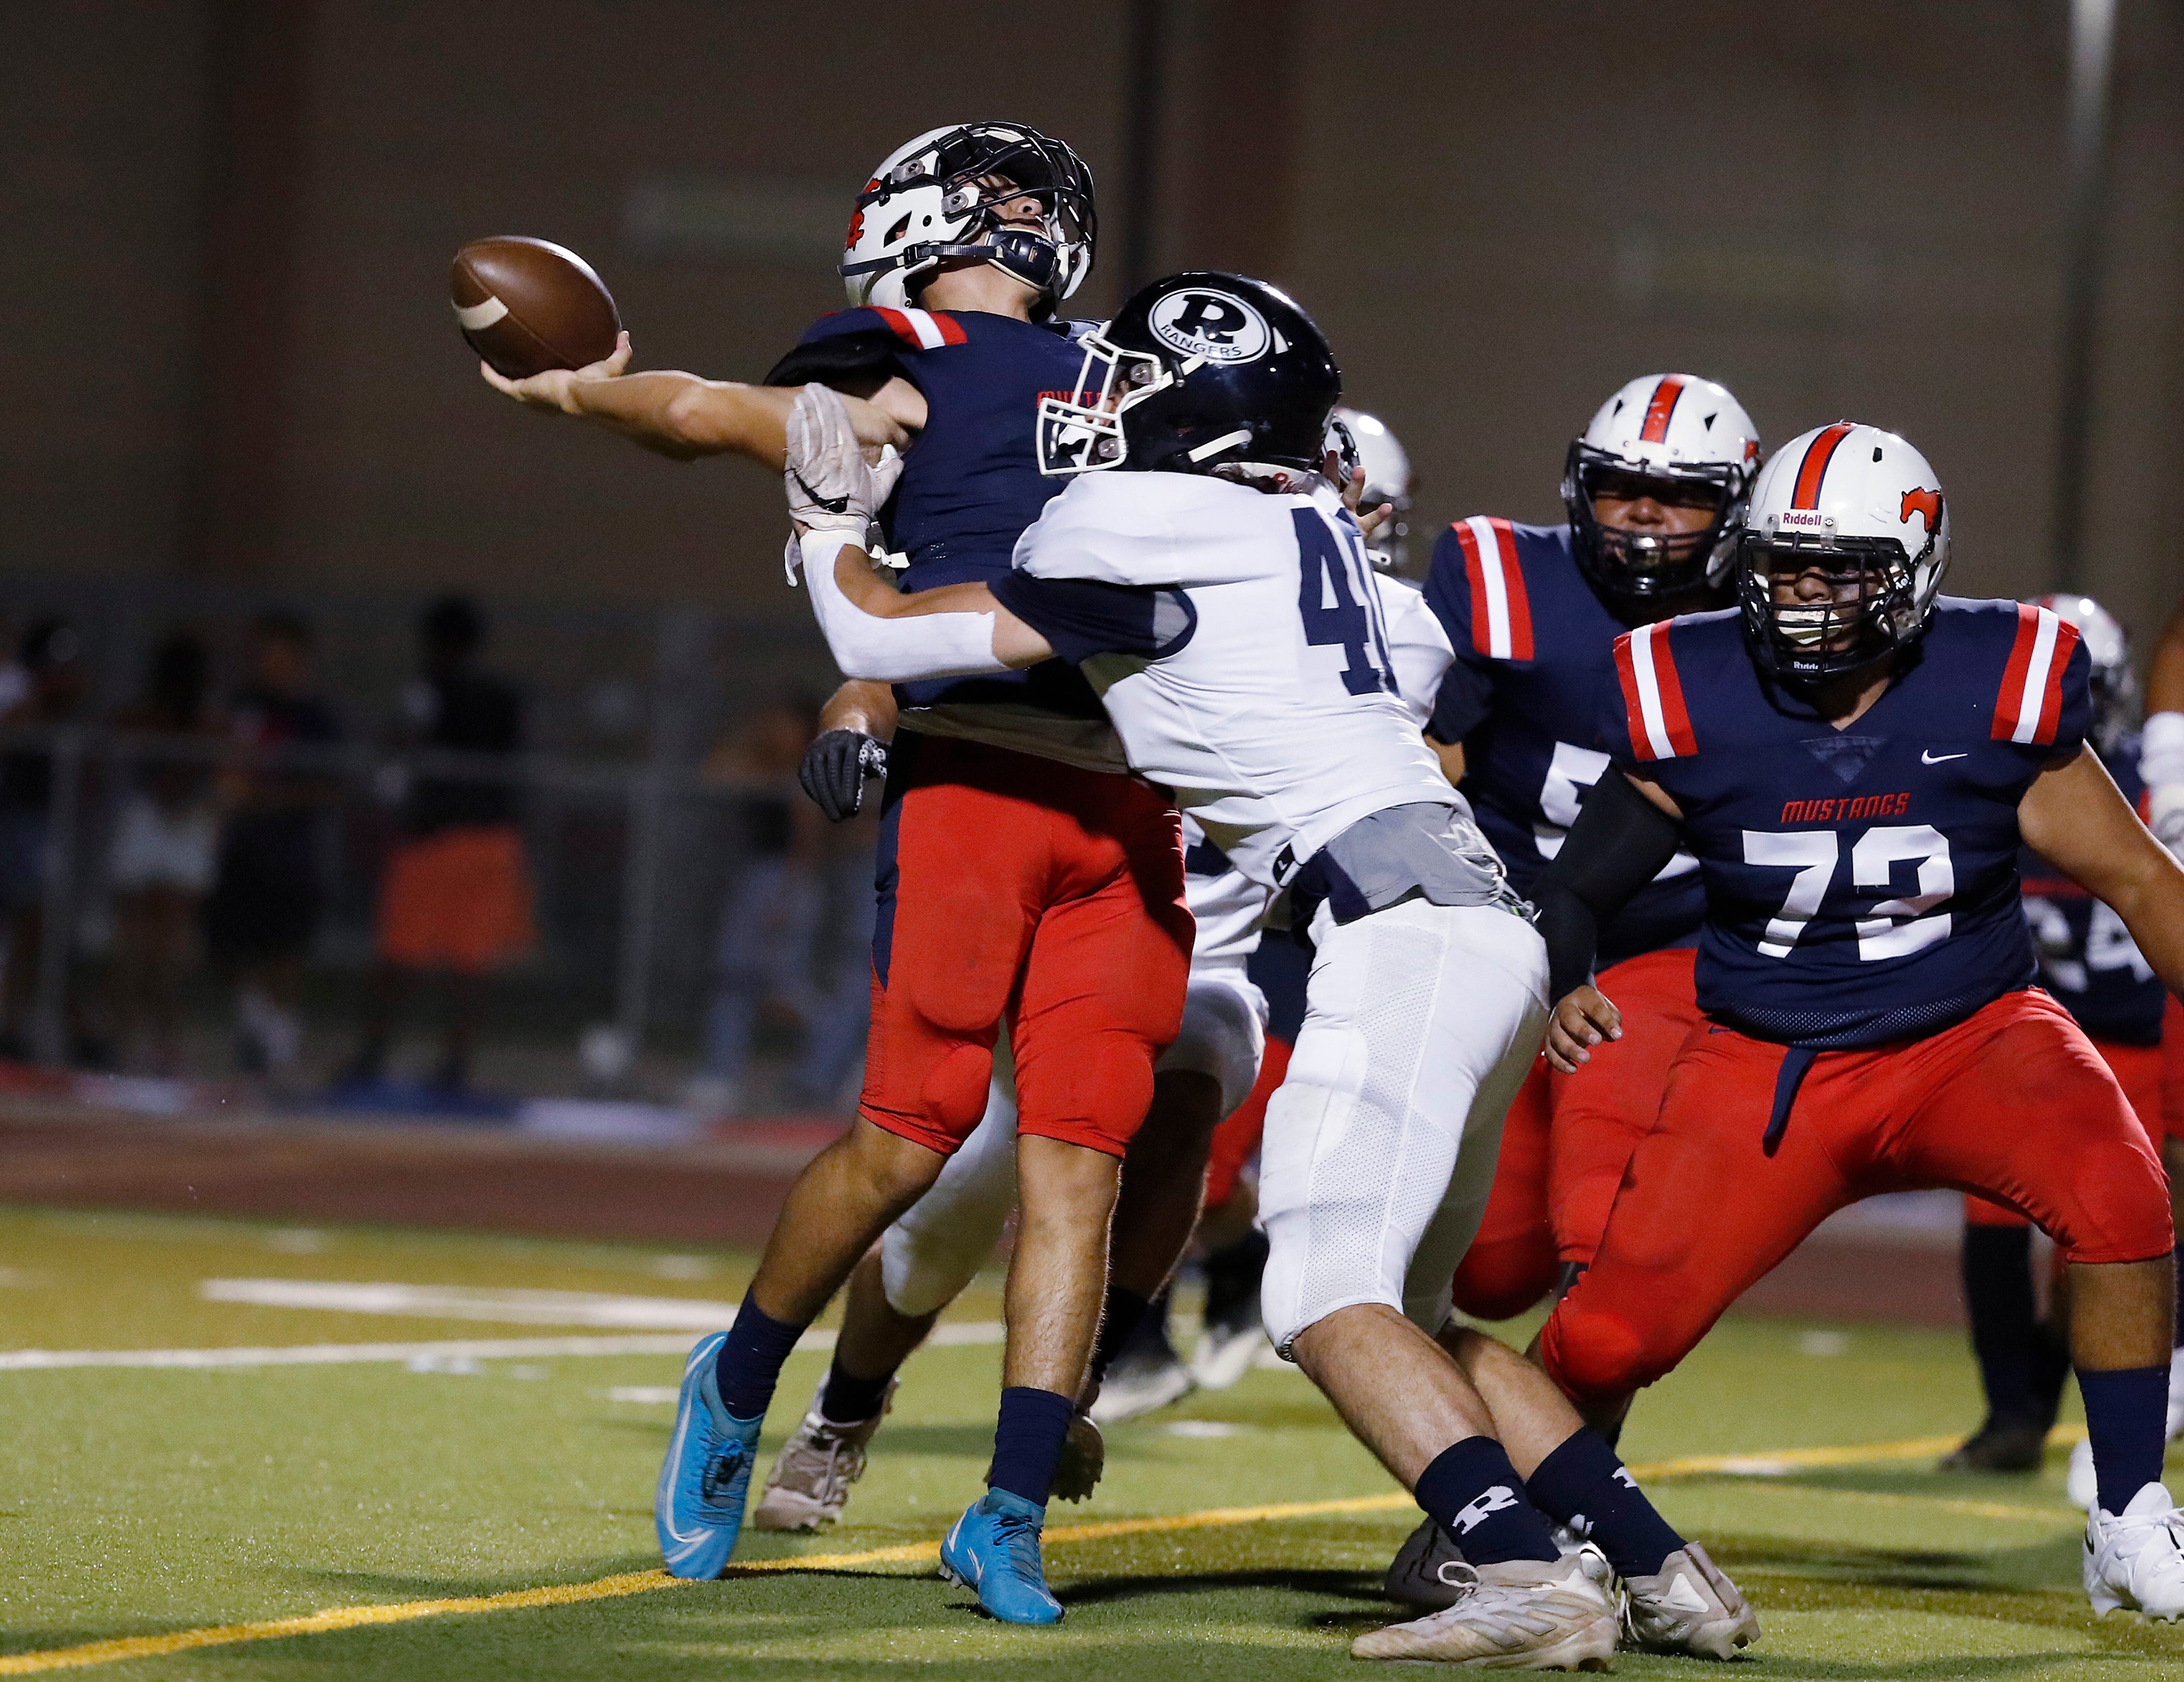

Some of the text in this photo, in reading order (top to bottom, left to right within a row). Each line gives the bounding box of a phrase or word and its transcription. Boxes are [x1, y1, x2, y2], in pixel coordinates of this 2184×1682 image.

[1172, 294, 1247, 344] R
[1160, 324, 1242, 357] RANGERS
[1783, 513, 1822, 526] Riddell
[1781, 792, 1910, 823] MUSTANGS
[1741, 824, 1955, 962] 72
[1452, 1485, 1519, 1535] R
